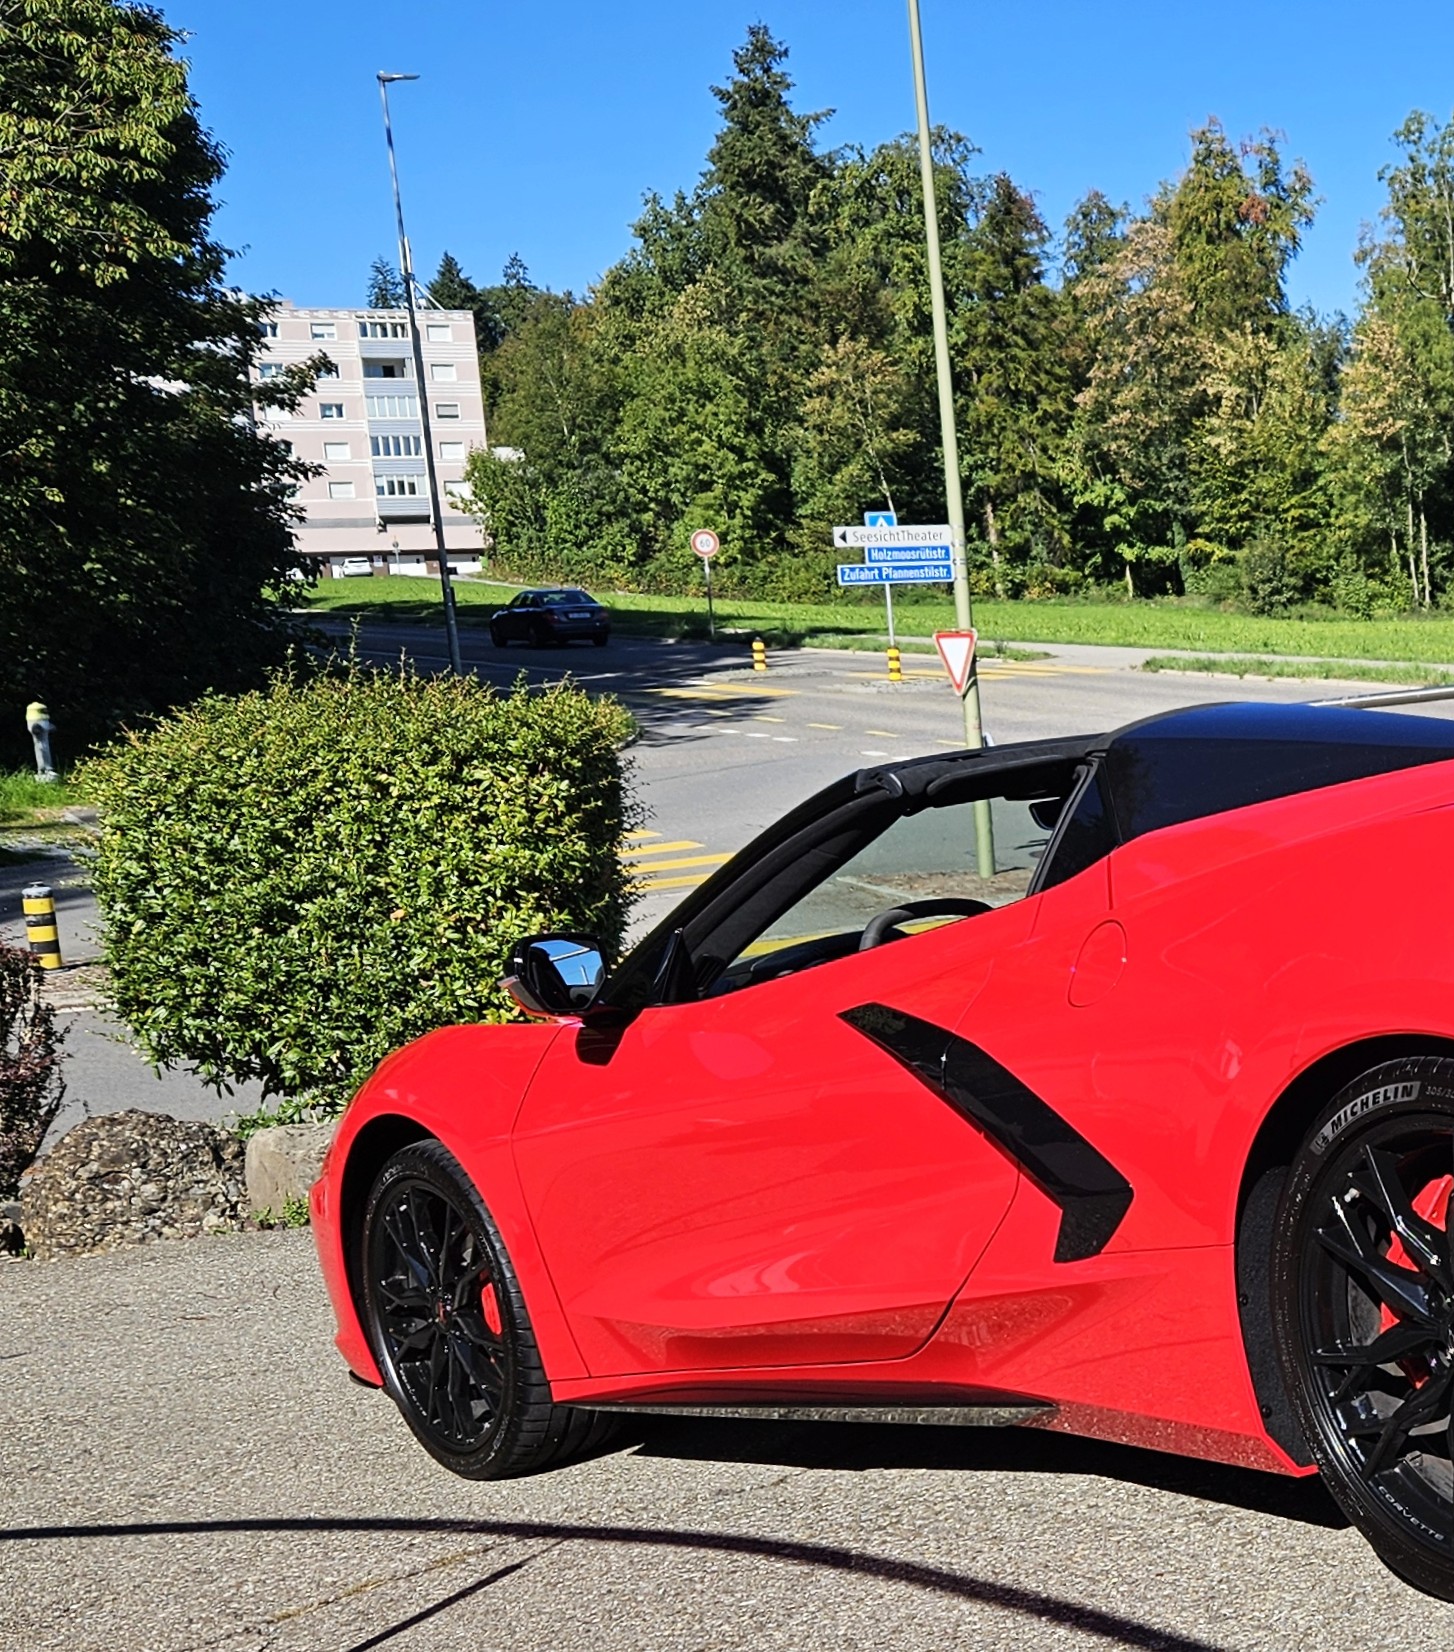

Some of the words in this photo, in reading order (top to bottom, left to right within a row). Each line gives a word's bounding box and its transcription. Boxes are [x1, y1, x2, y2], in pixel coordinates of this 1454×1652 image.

[852, 530, 943, 543] SeesichtTheater
[843, 568, 879, 581] Zufahrt
[1330, 1084, 1414, 1134] MICHELIN
[1378, 1485, 1445, 1541] CORVETTE
